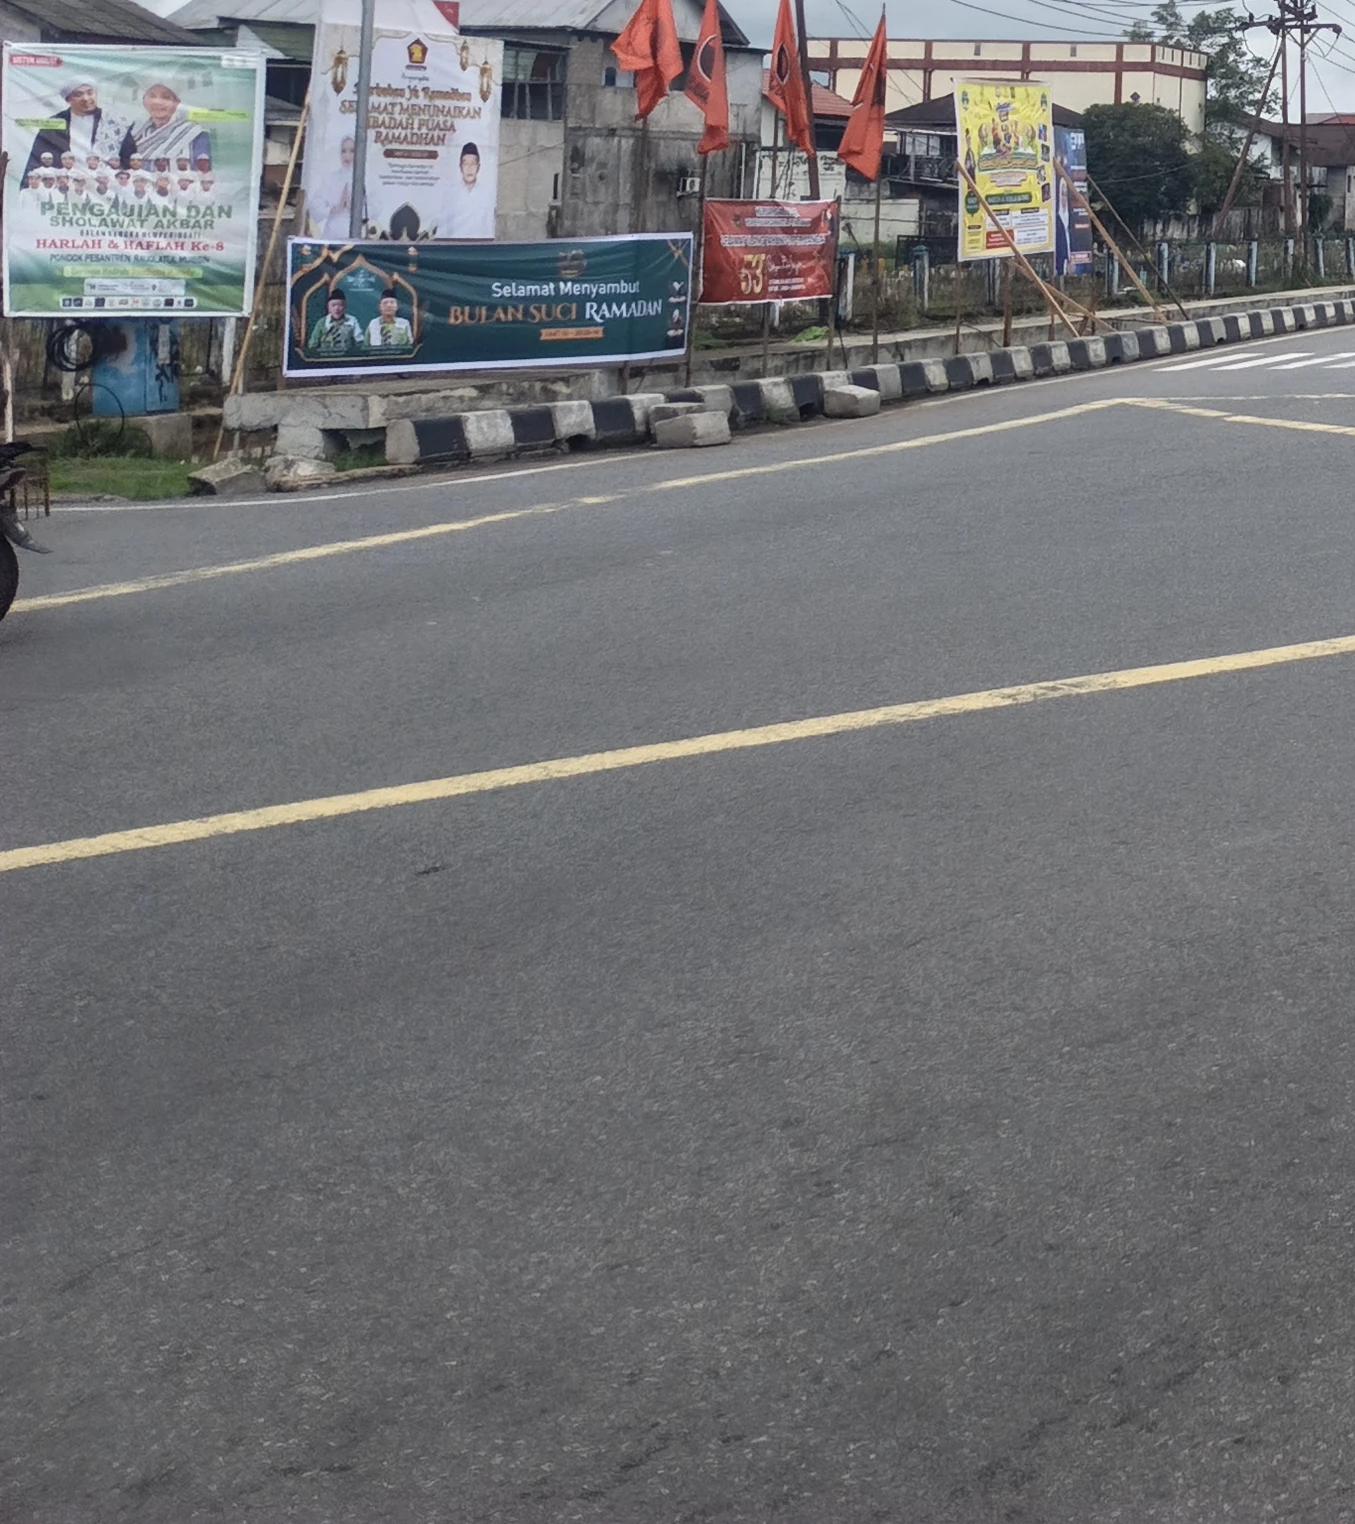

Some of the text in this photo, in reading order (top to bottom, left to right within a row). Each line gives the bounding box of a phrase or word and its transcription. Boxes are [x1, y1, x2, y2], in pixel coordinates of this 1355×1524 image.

[339, 99, 482, 119] SEMAT MENUNAIKAN
[417, 119, 457, 133] PUASA
[374, 130, 447, 147] RAMADHAN
[40, 201, 233, 219] PENGAJIAN DAN
[49, 215, 215, 230] SHOLAWAT AKBAR
[36, 238, 101, 250] HARLAH
[107, 240, 119, 250] &
[491, 279, 640, 298] Selamat Menyambut
[448, 299, 662, 325] BULAN SUCI RAMADAN
